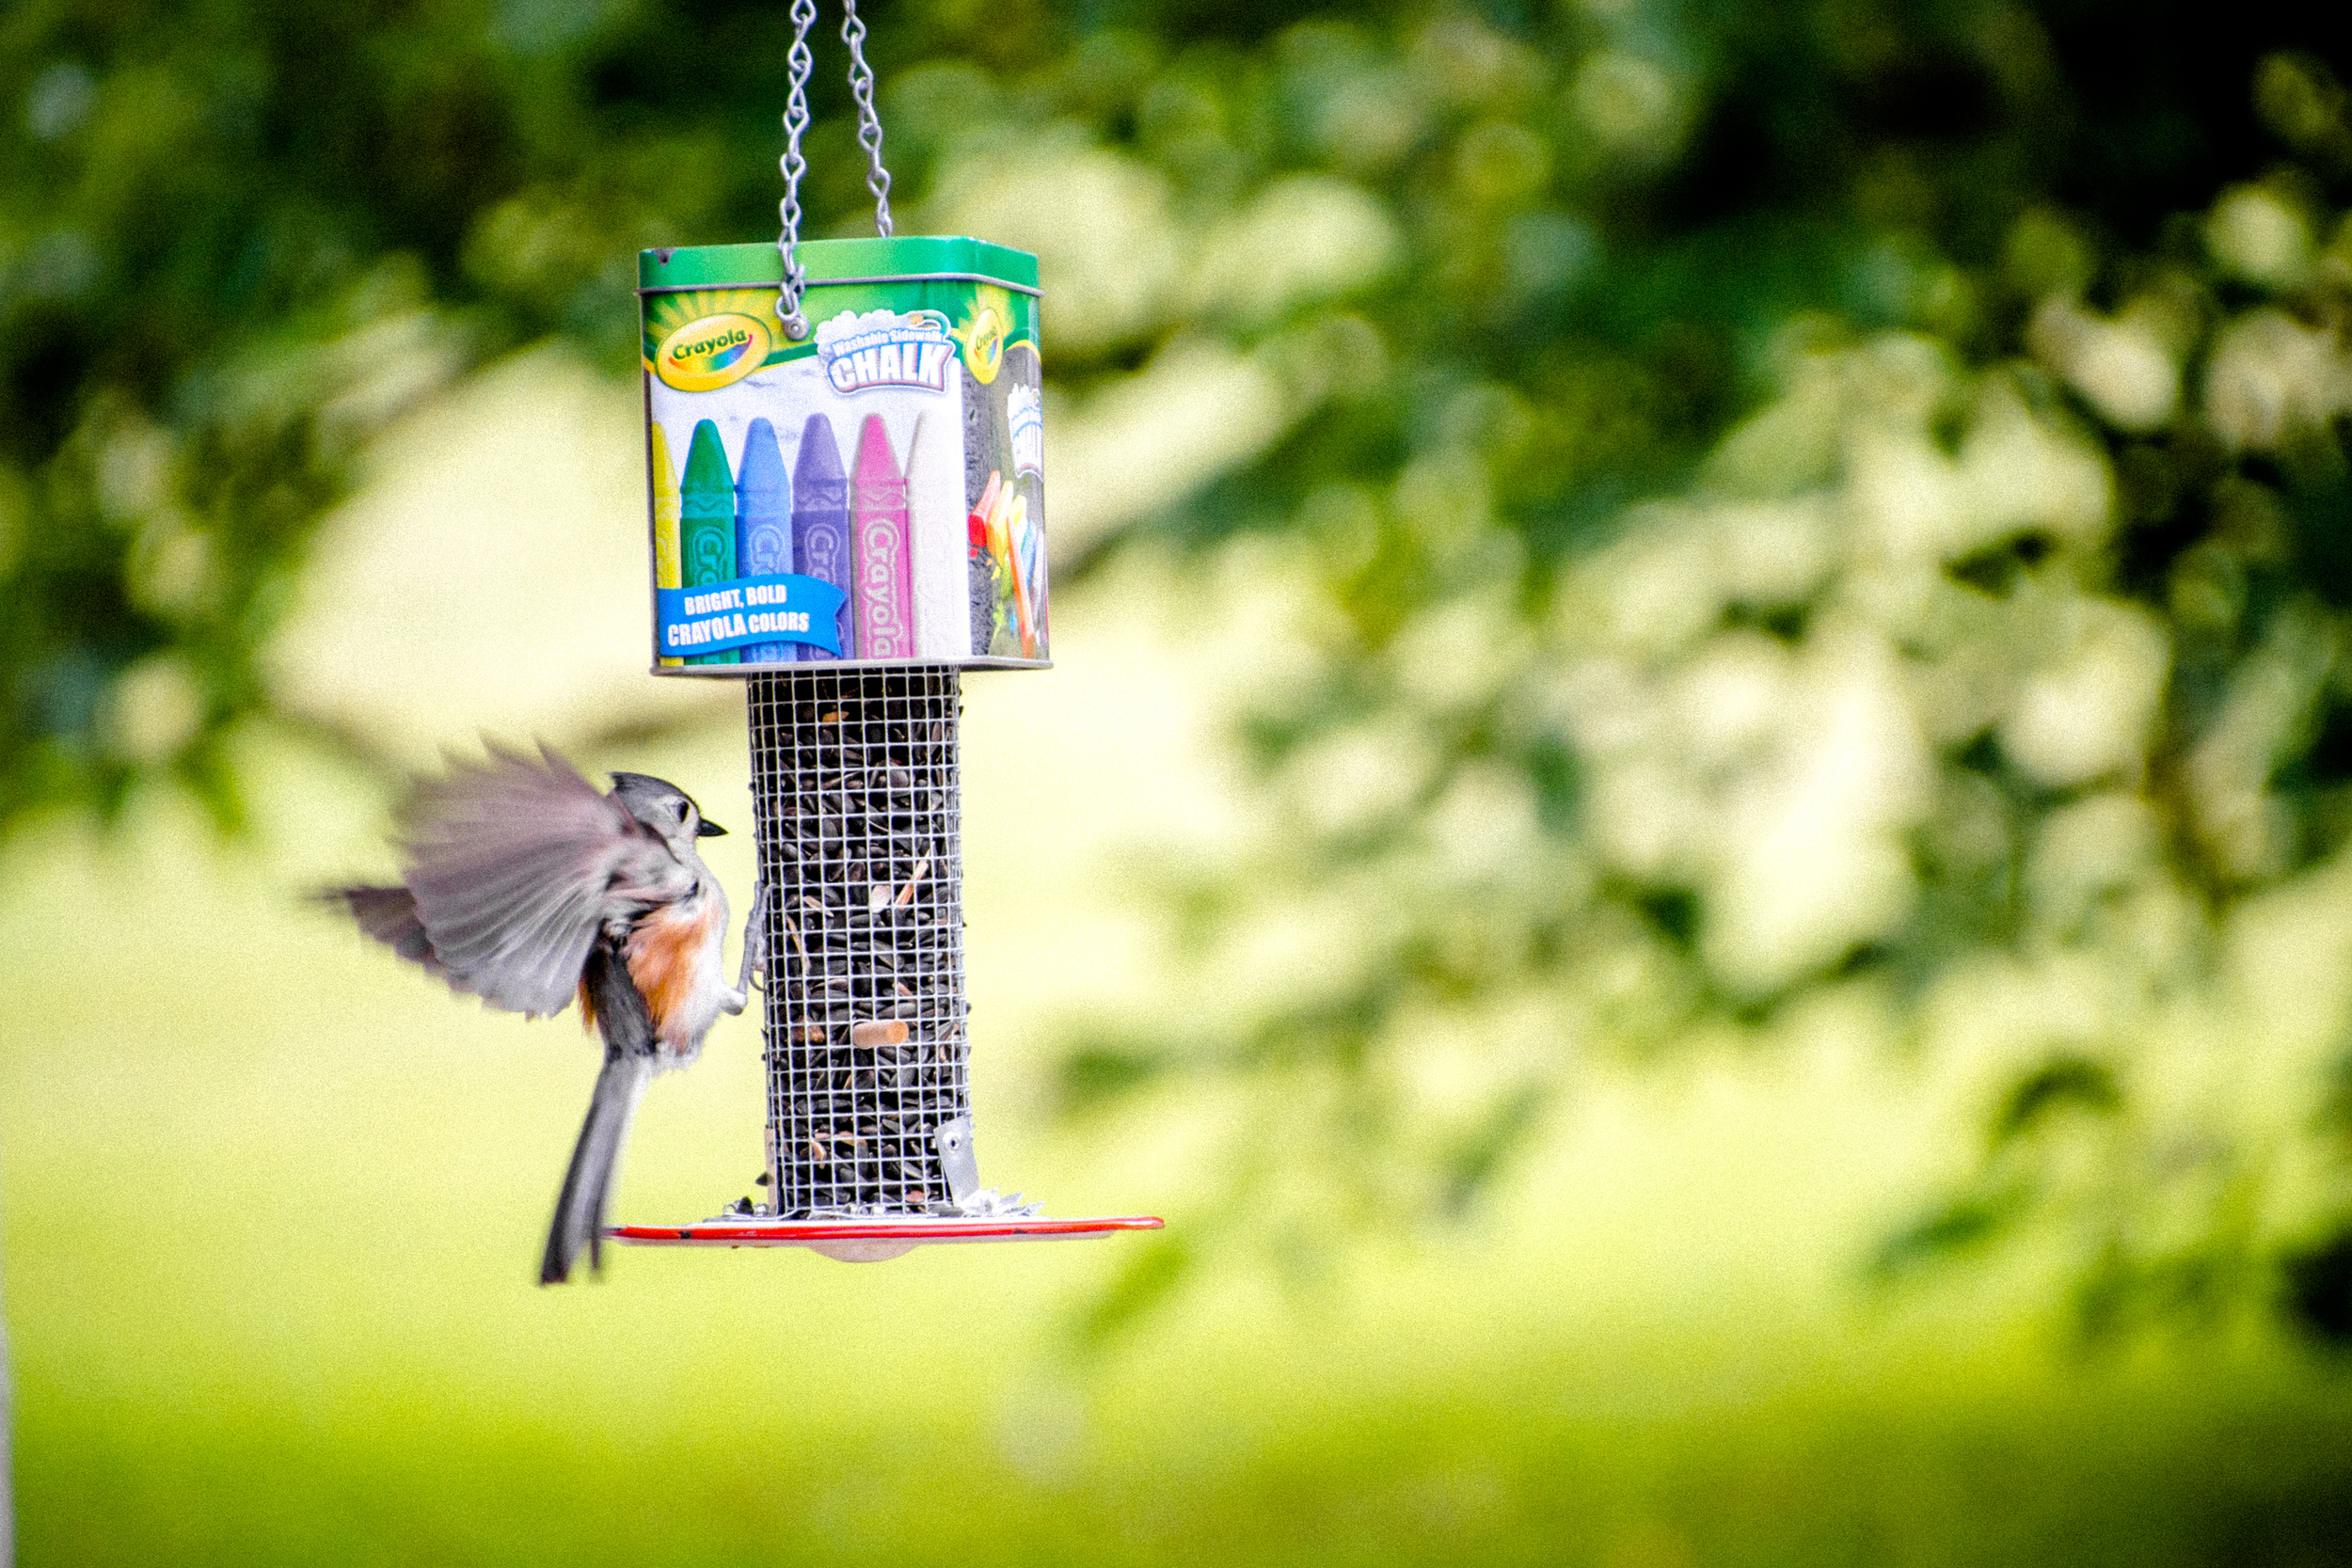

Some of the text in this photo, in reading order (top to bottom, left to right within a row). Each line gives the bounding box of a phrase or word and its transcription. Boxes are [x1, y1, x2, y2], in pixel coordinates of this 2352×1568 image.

[673, 329, 747, 359] Crayola
[832, 328, 943, 356] Washable Sidewalk
[835, 341, 946, 390] CHALK
[684, 584, 787, 615] BRIGHT, BOLD
[866, 527, 897, 657] Crayola
[668, 611, 810, 646] CRAYOLA COLORS
